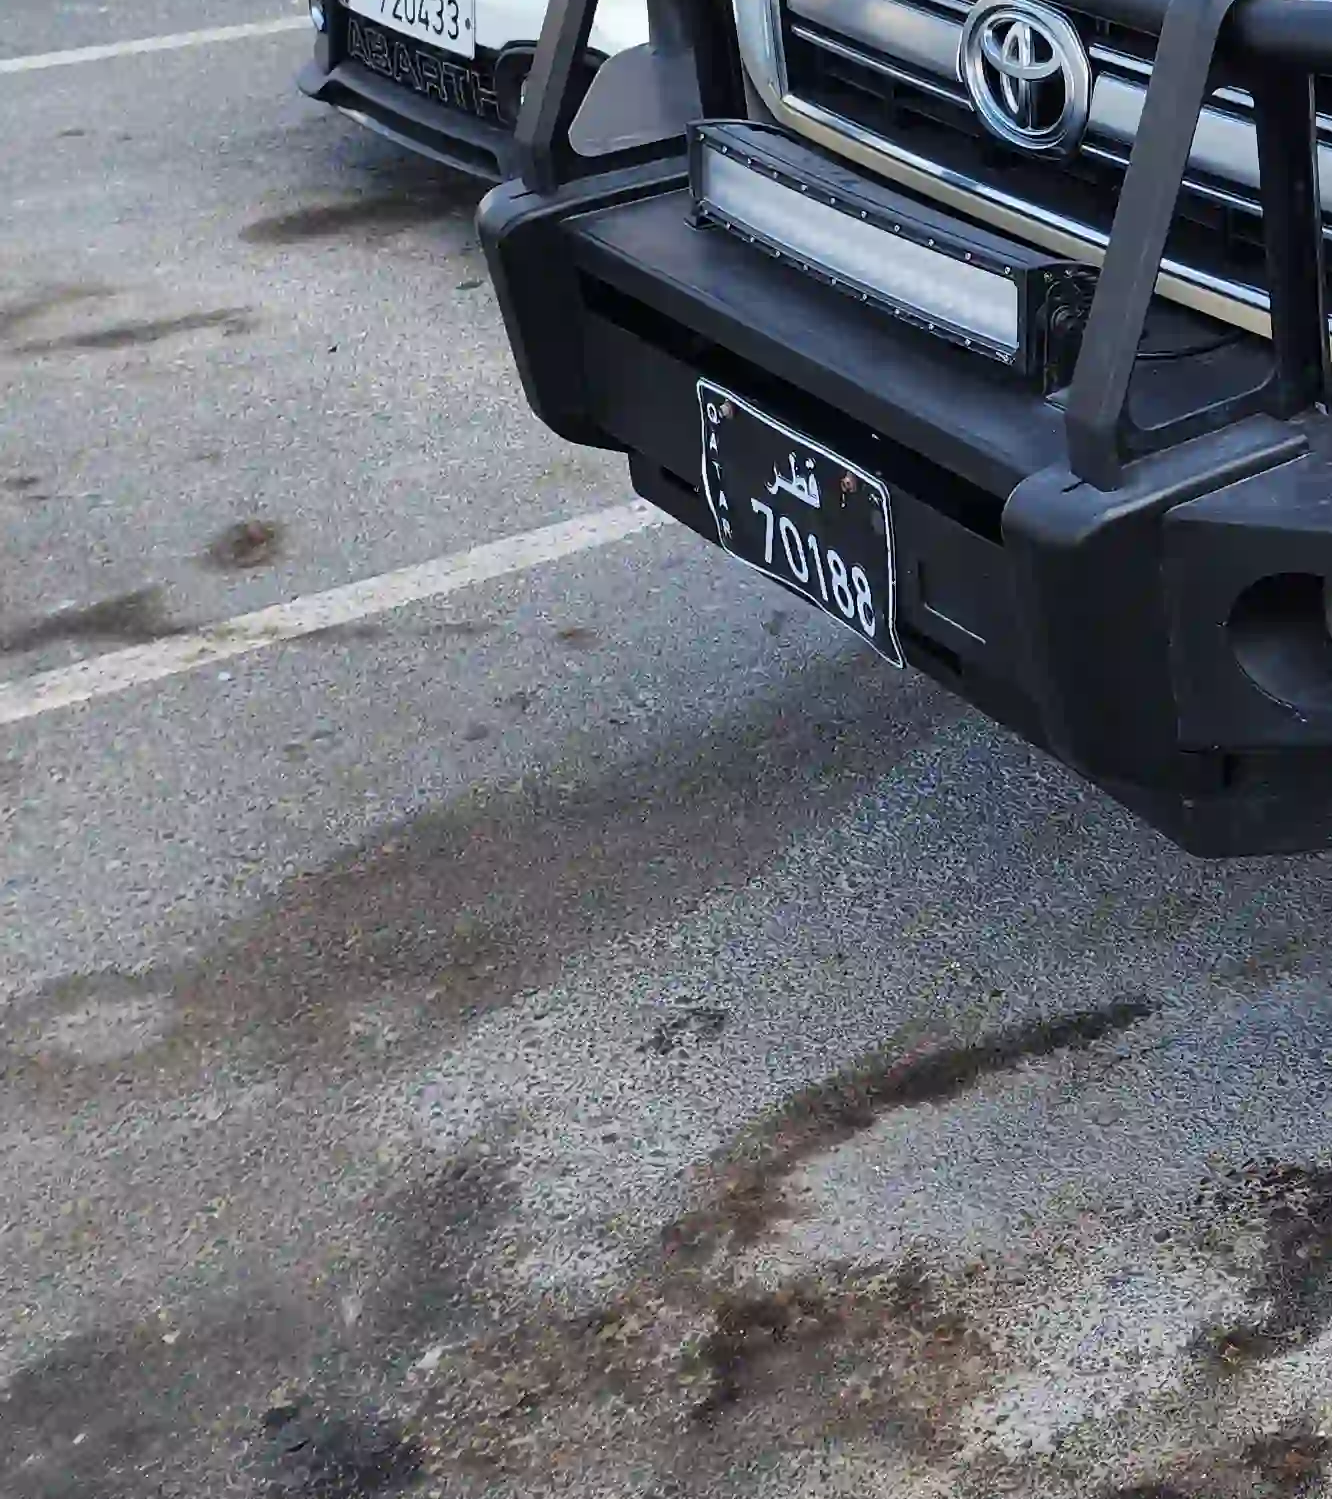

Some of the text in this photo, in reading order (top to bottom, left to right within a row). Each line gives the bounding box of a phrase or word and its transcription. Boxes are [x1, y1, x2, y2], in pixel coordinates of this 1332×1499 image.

[348, 17, 508, 124] ABARTH
[706, 402, 733, 540] QATAR
[765, 451, 820, 509] قطر
[751, 497, 876, 638] 70188
